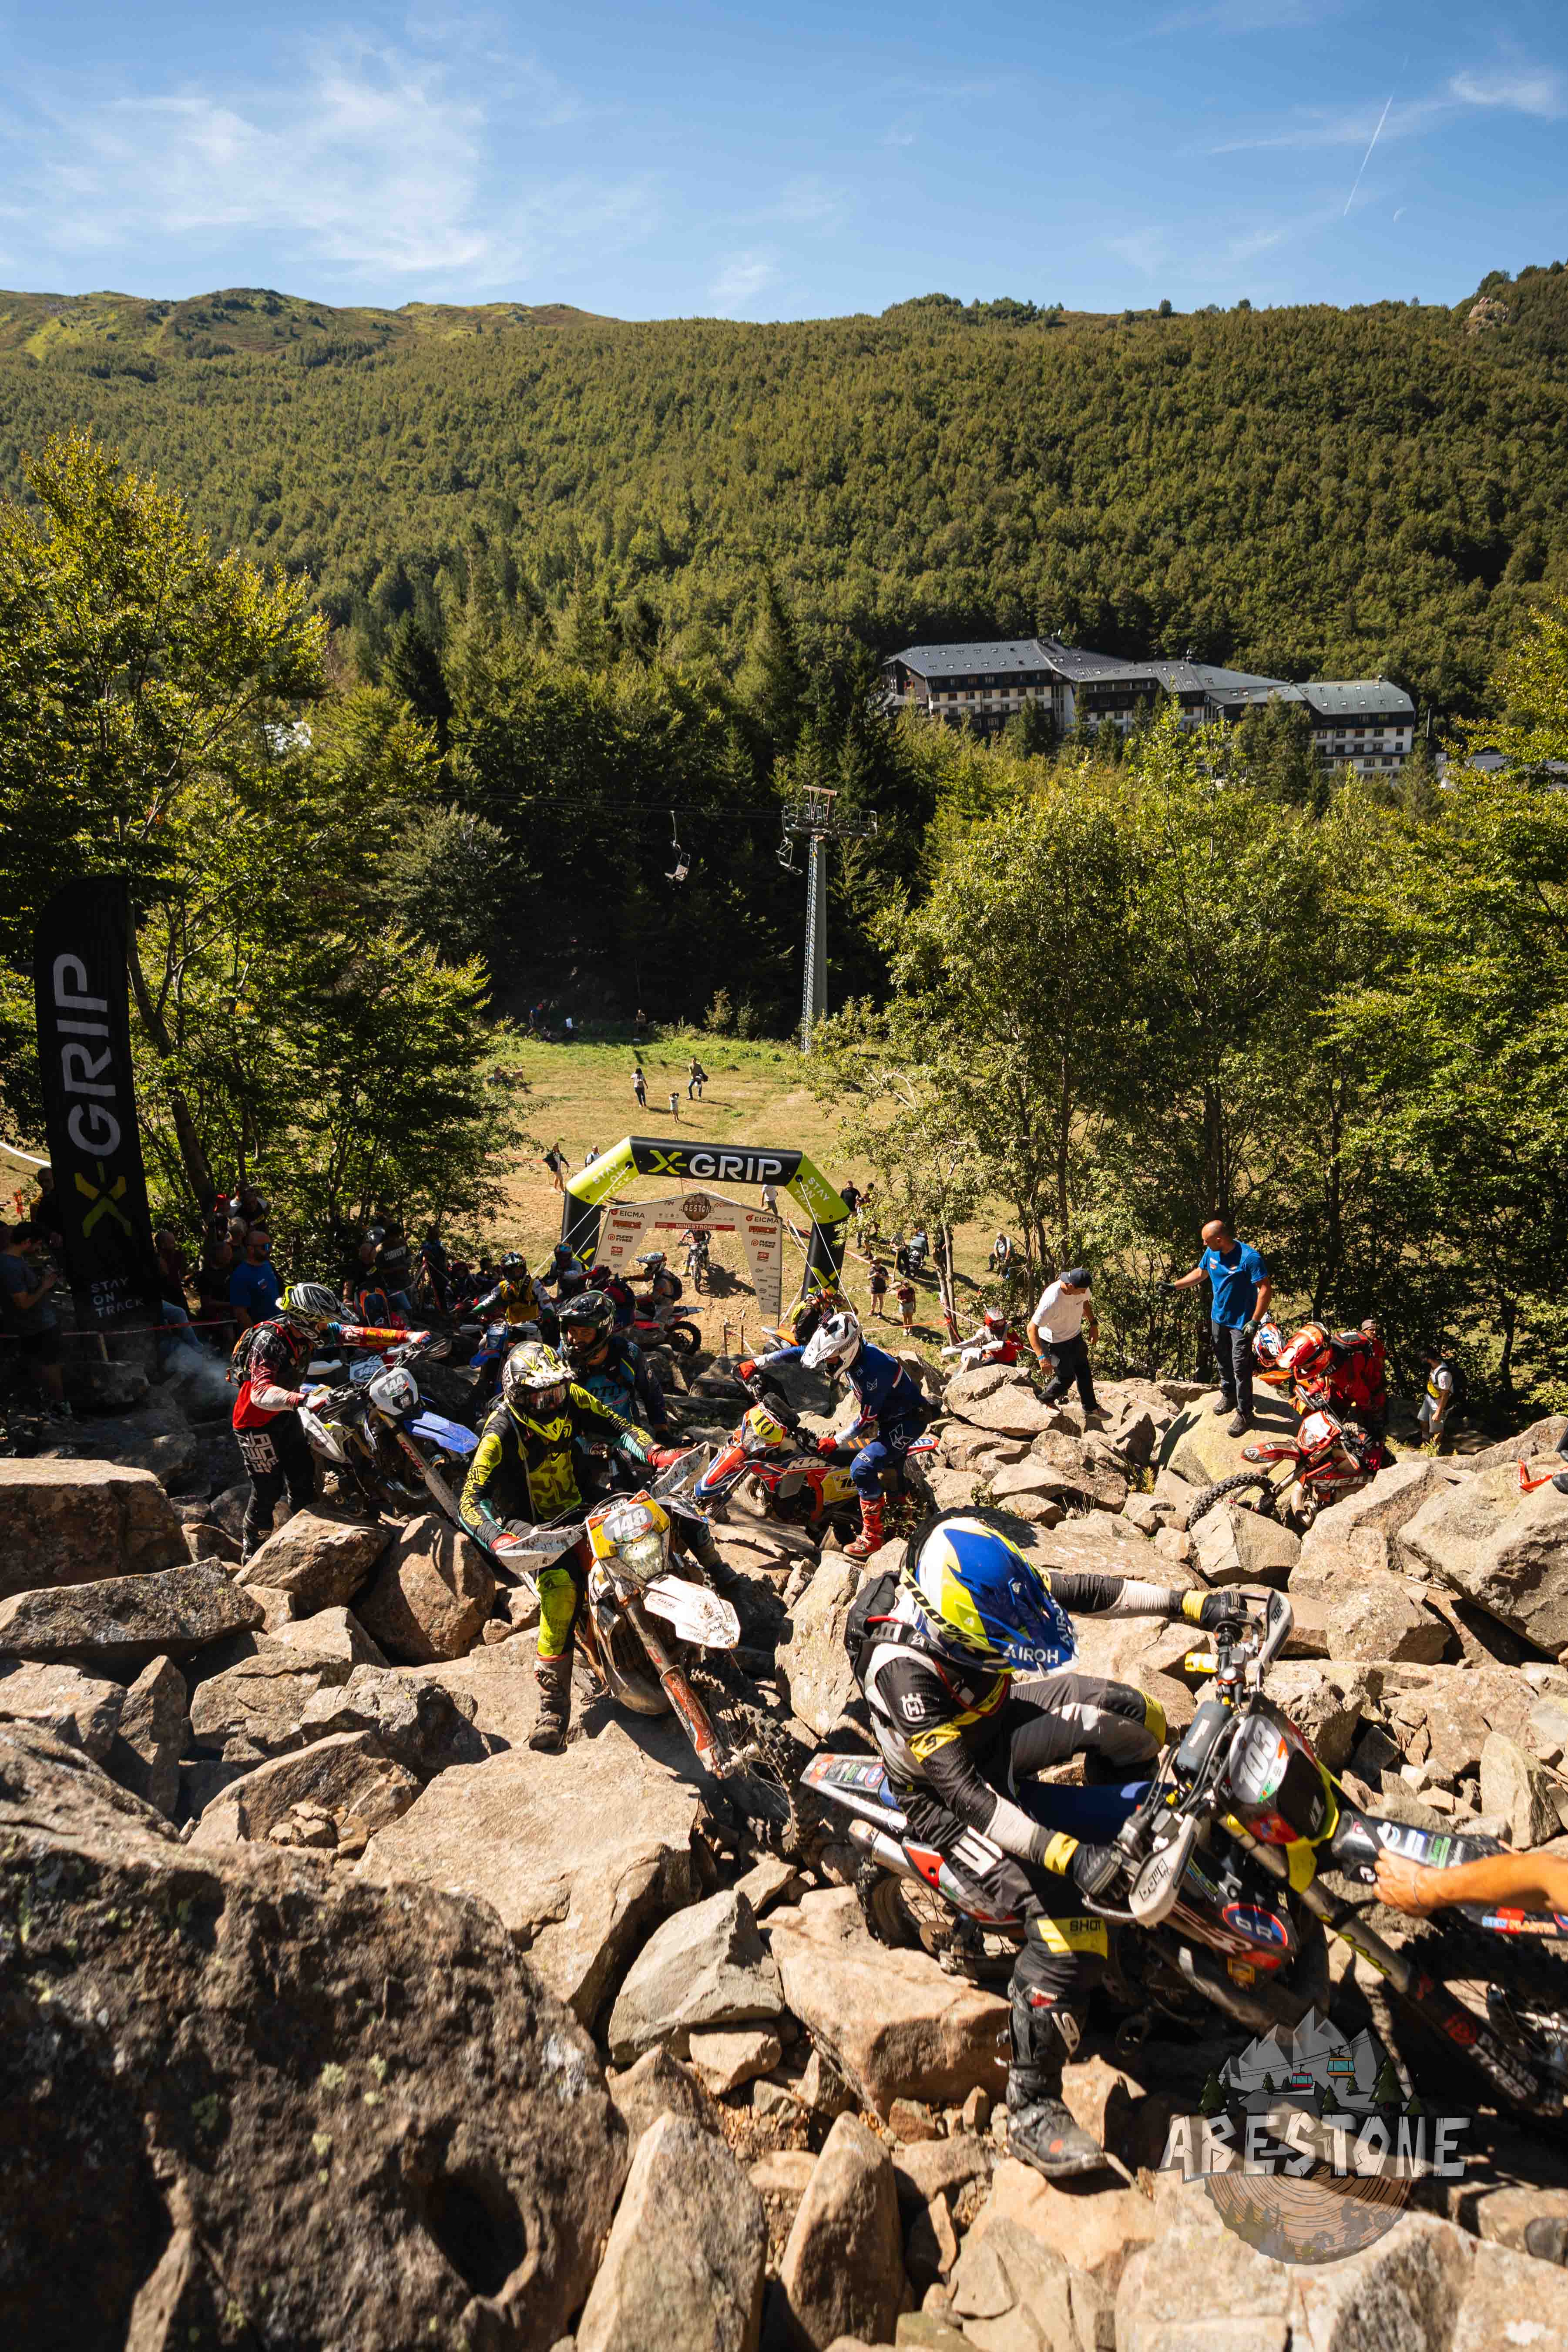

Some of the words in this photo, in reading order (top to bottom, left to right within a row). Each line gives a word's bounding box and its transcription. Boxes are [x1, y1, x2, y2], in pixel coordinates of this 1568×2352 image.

[592, 1161, 618, 1184] STAY
[648, 1150, 782, 1181] X-GRIP
[808, 1177, 829, 1201] STAY
[679, 1204, 715, 1213] ABESTONE
[91, 1277, 129, 1293] STAY
[93, 1291, 114, 1305] ON
[95, 1298, 144, 1317] TRACK
[755, 1414, 775, 1436] 10
[787, 1456, 827, 1470] KTM
[609, 1508, 648, 1539] 148
[904, 1581, 971, 1643] 100%
[1003, 1643, 1059, 1664] AIROH
[1070, 1920, 1101, 1932] SHOT
